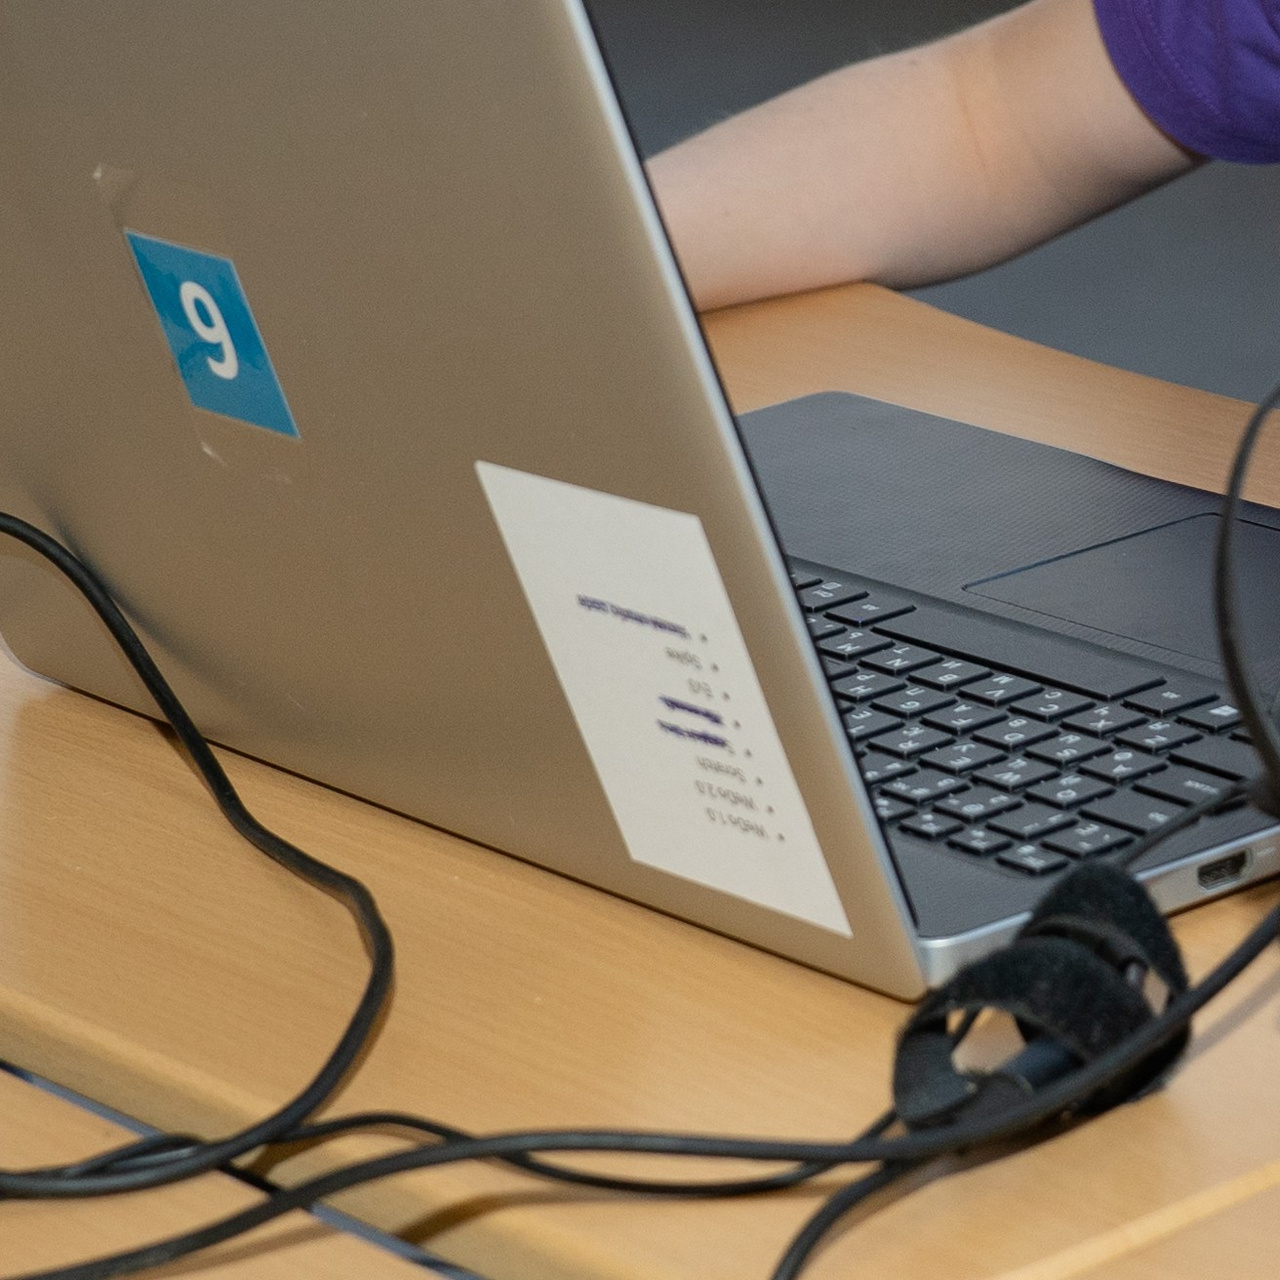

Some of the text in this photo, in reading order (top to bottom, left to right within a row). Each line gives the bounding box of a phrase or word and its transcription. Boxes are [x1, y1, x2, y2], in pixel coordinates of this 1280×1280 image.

[179, 280, 239, 380] 9
[885, 658, 910, 667] N
[849, 685, 874, 694] H
[900, 701, 921, 709] G
[1003, 732, 1026, 742] D
